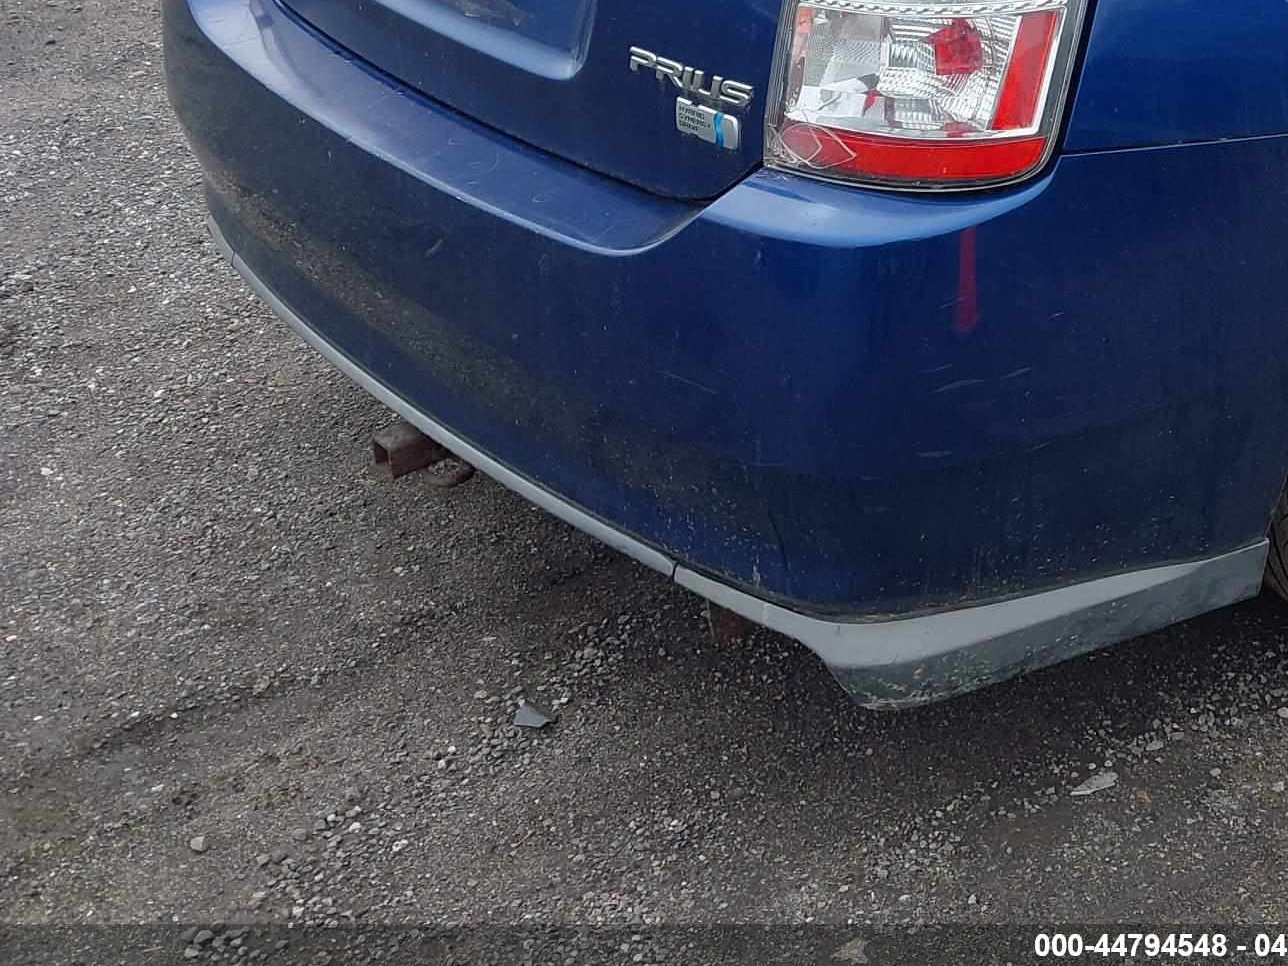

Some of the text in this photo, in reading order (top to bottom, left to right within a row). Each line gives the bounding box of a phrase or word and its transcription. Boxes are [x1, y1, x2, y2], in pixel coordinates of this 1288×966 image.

[629, 46, 754, 108] PRIUS
[678, 105, 705, 120] HYBRID
[678, 113, 712, 129] SYNERGY
[678, 120, 700, 132] DRIVE
